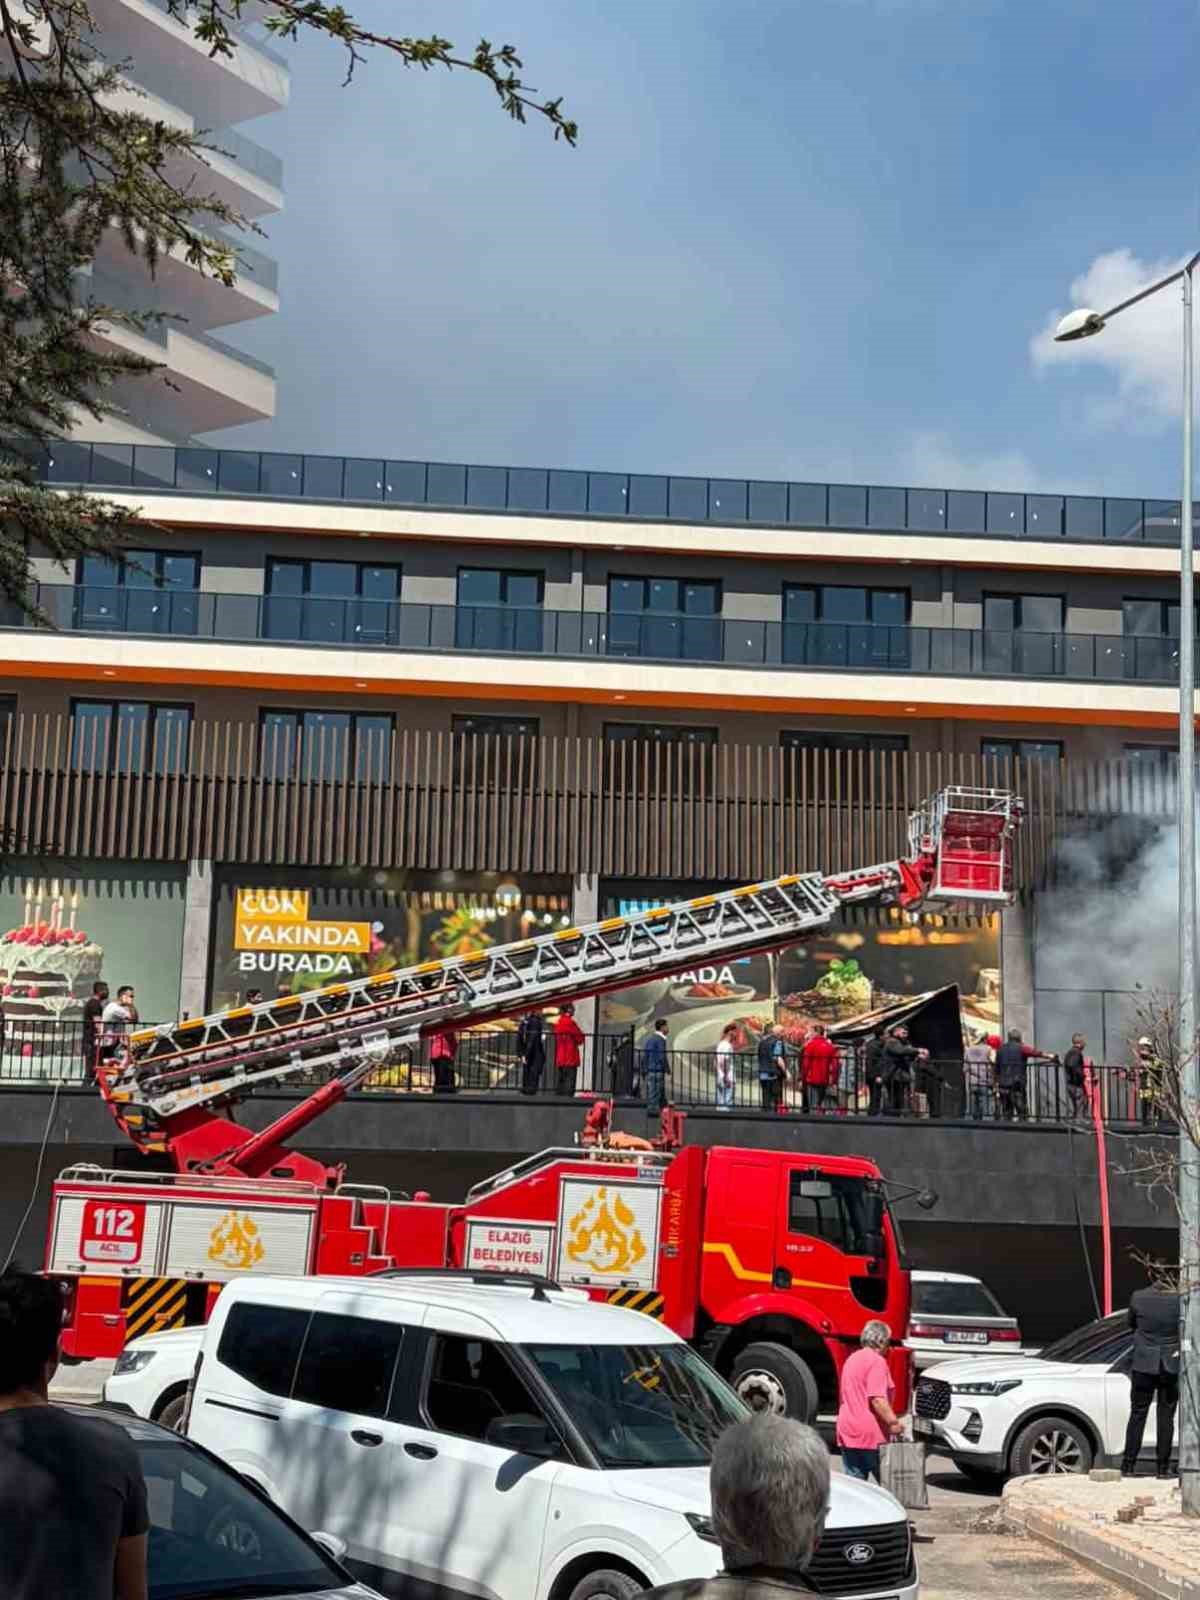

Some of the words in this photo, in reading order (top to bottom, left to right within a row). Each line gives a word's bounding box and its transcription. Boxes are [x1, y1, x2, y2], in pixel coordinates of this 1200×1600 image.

[242, 894, 299, 918] ÇOK
[240, 924, 361, 946] YAKINDA
[239, 952, 353, 974] BURADA
[93, 1208, 135, 1237] 112
